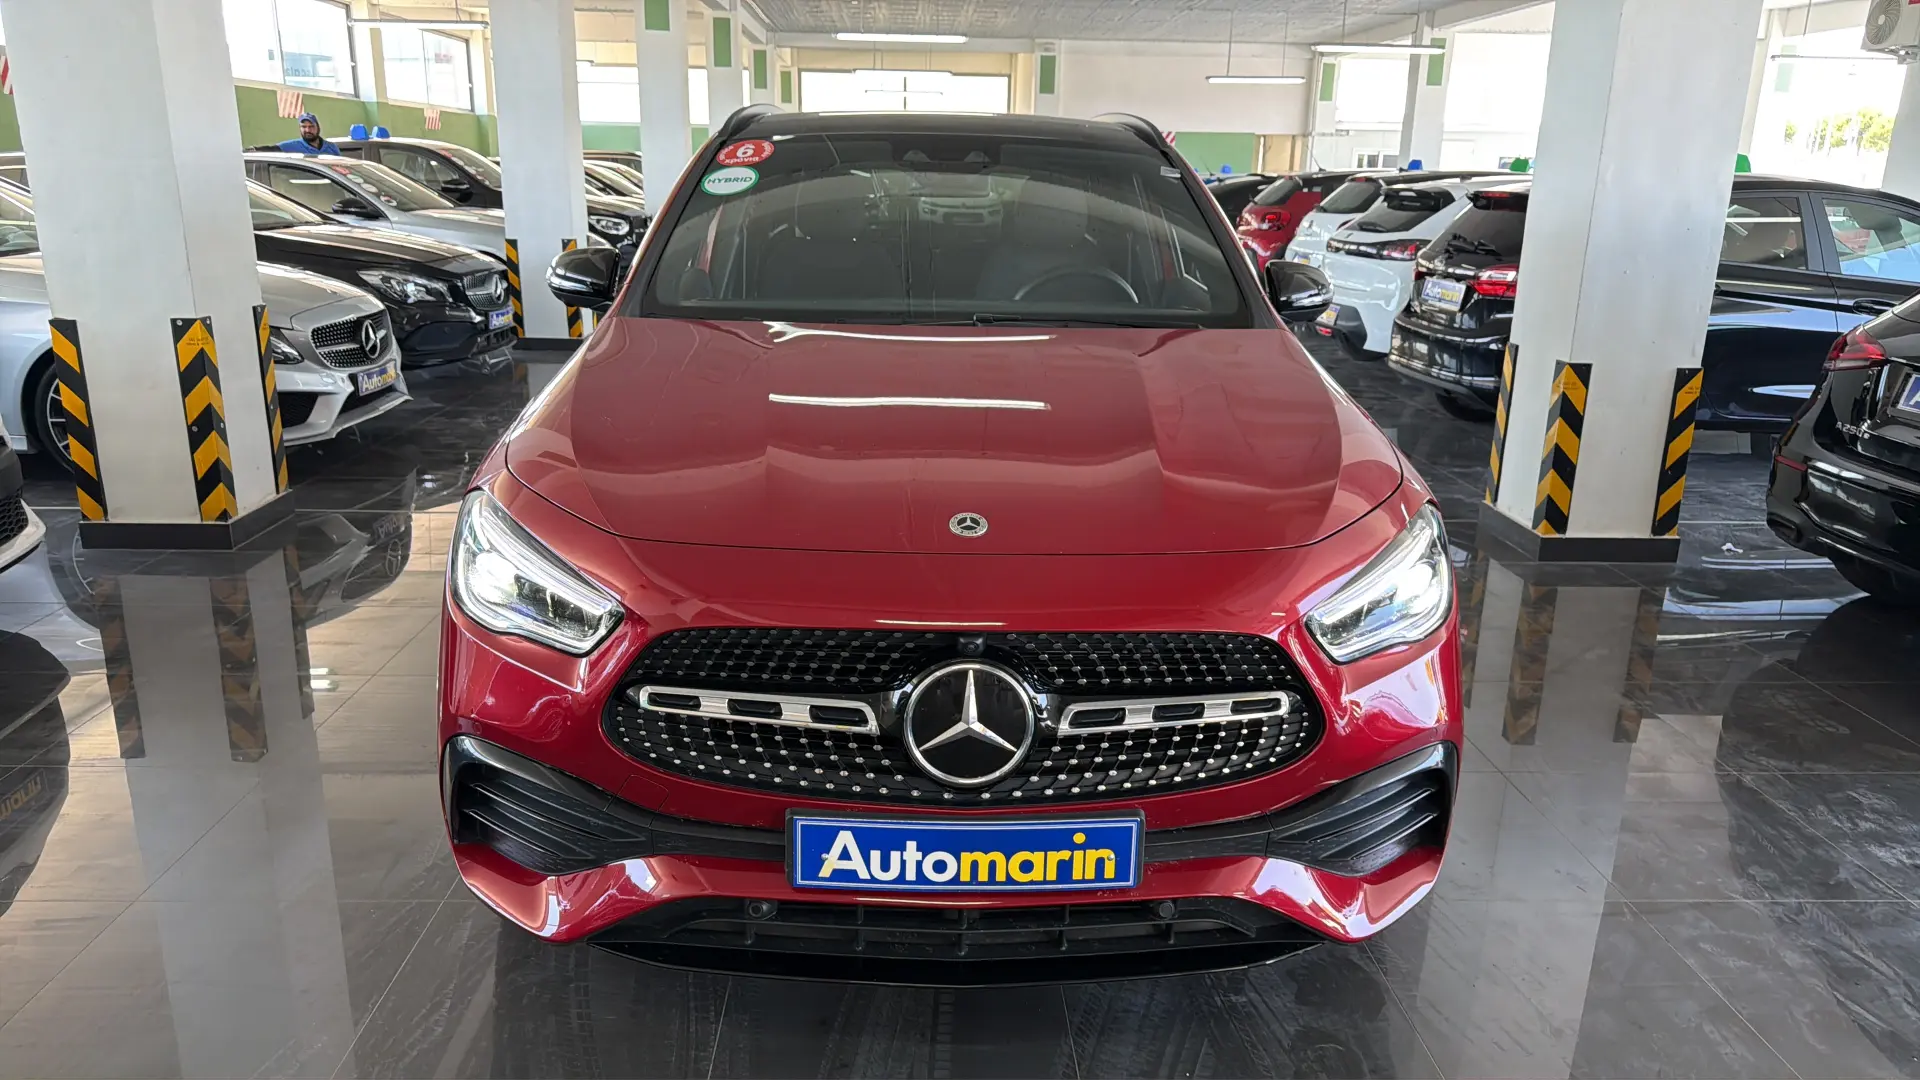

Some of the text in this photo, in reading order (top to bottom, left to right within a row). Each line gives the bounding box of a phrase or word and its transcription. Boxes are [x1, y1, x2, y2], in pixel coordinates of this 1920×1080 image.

[736, 143, 756, 158] 6
[707, 176, 753, 185] HYBRID
[818, 830, 1115, 882] Automarin
